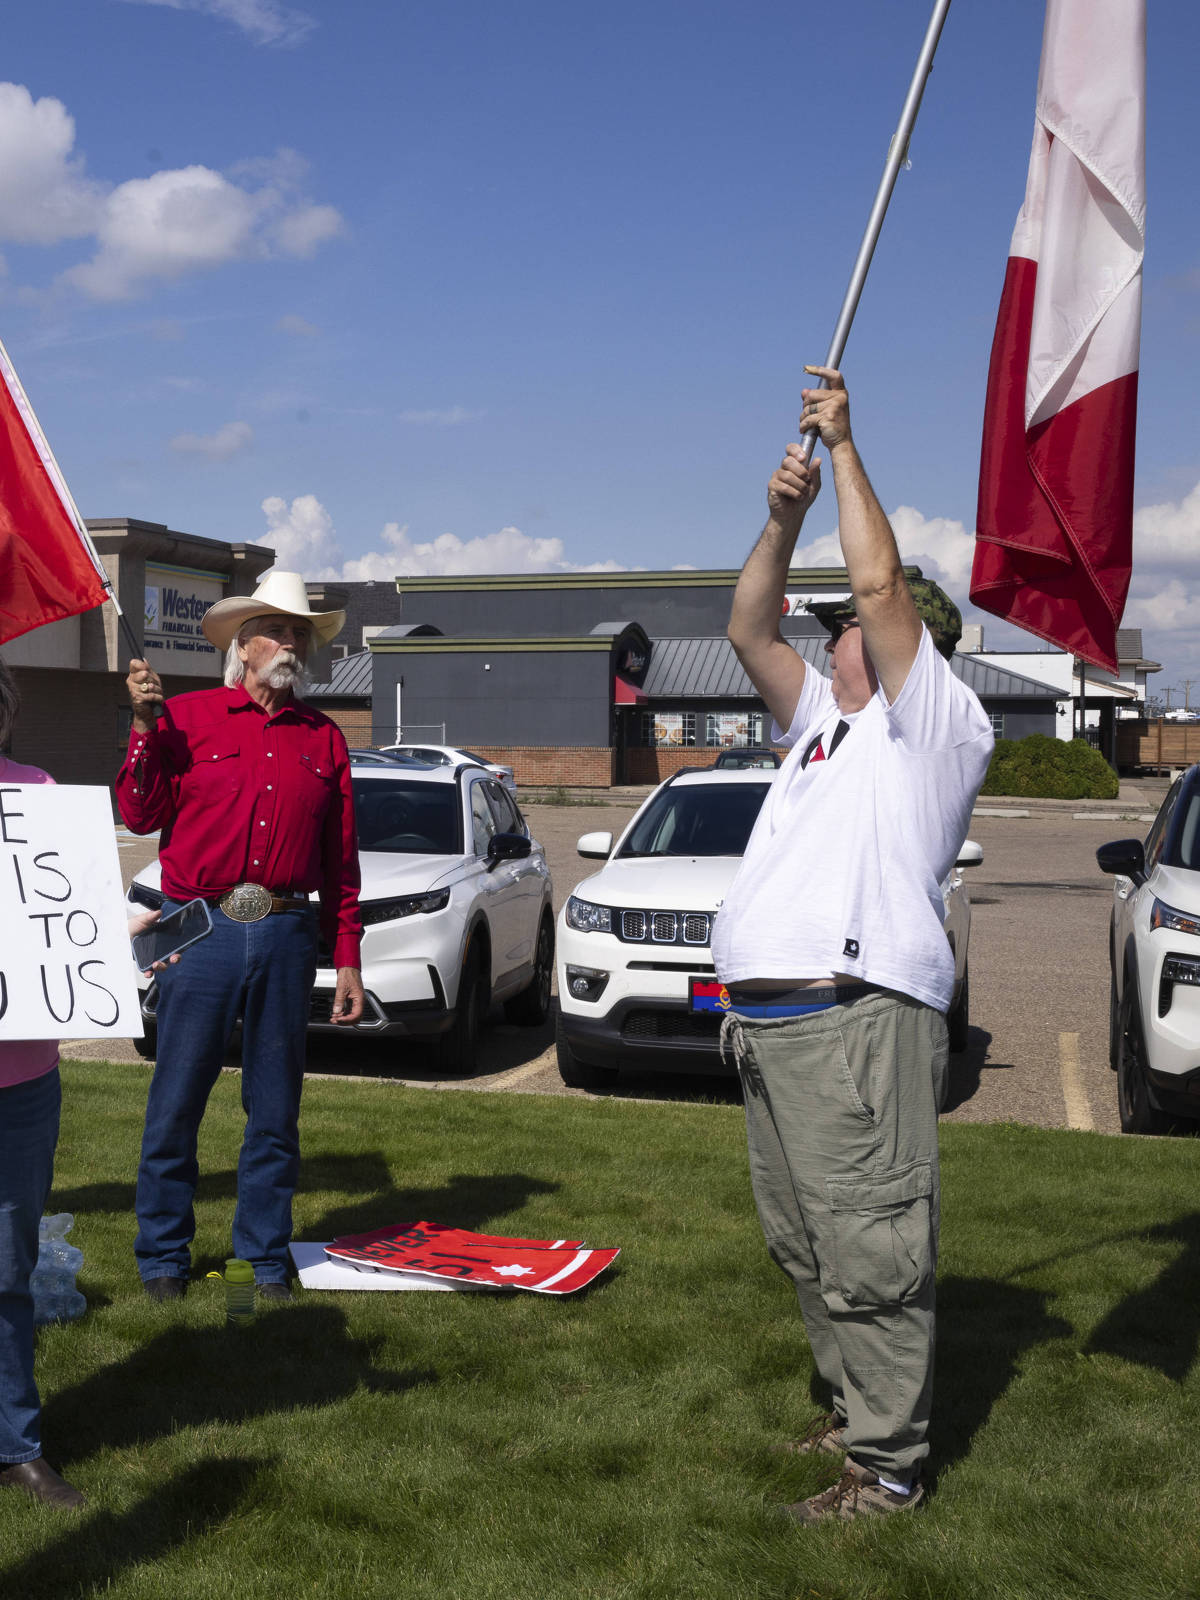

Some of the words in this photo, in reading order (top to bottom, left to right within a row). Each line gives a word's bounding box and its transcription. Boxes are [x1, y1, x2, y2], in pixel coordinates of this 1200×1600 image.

[162, 587, 217, 621] Wester
[13, 852, 71, 903] IS
[28, 910, 98, 948] TO
[40, 960, 119, 1027] US
[345, 1229, 441, 1261] NEVER
